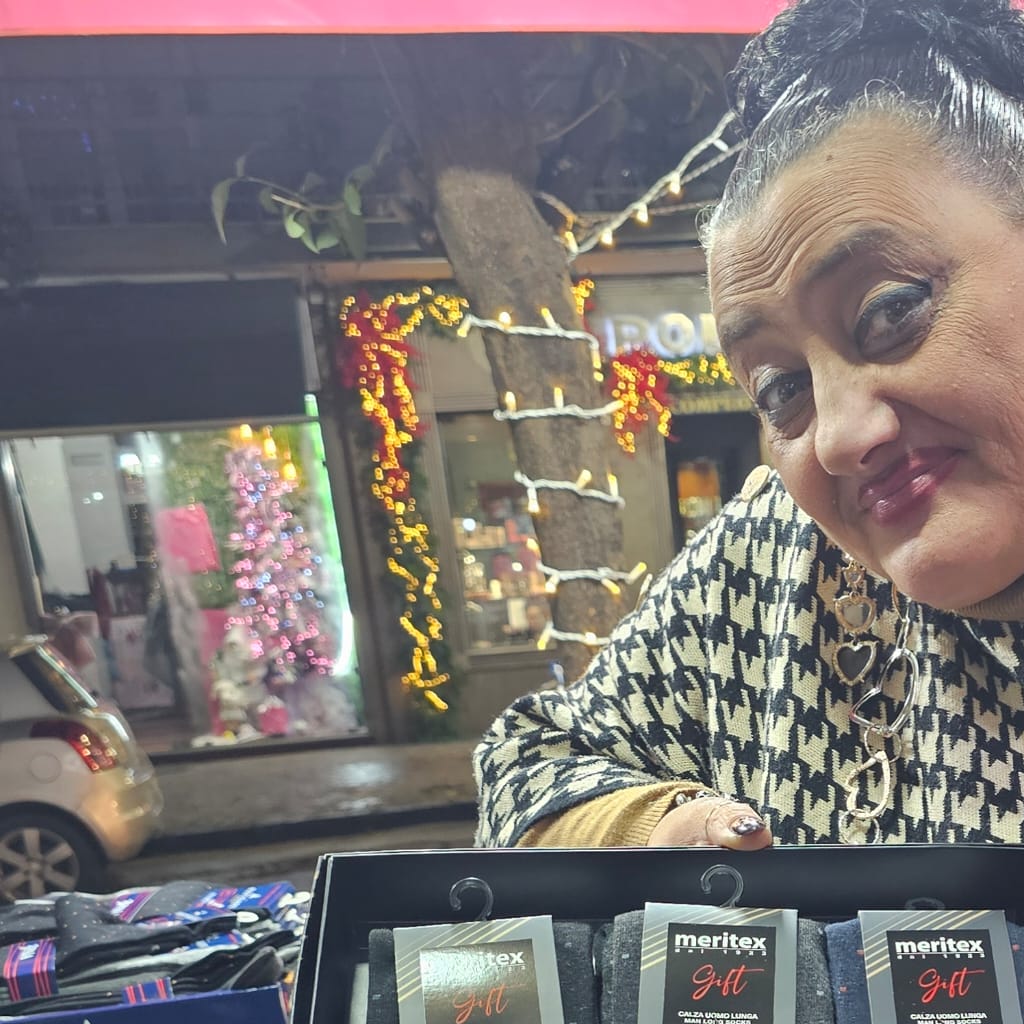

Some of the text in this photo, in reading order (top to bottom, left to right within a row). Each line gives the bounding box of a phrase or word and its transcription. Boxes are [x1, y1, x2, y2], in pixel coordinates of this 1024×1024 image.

[674, 931, 767, 949] meritex
[895, 937, 984, 953] meritex
[692, 964, 765, 1000] Gift
[918, 967, 985, 1003] Gift
[453, 984, 526, 1024] Gift
